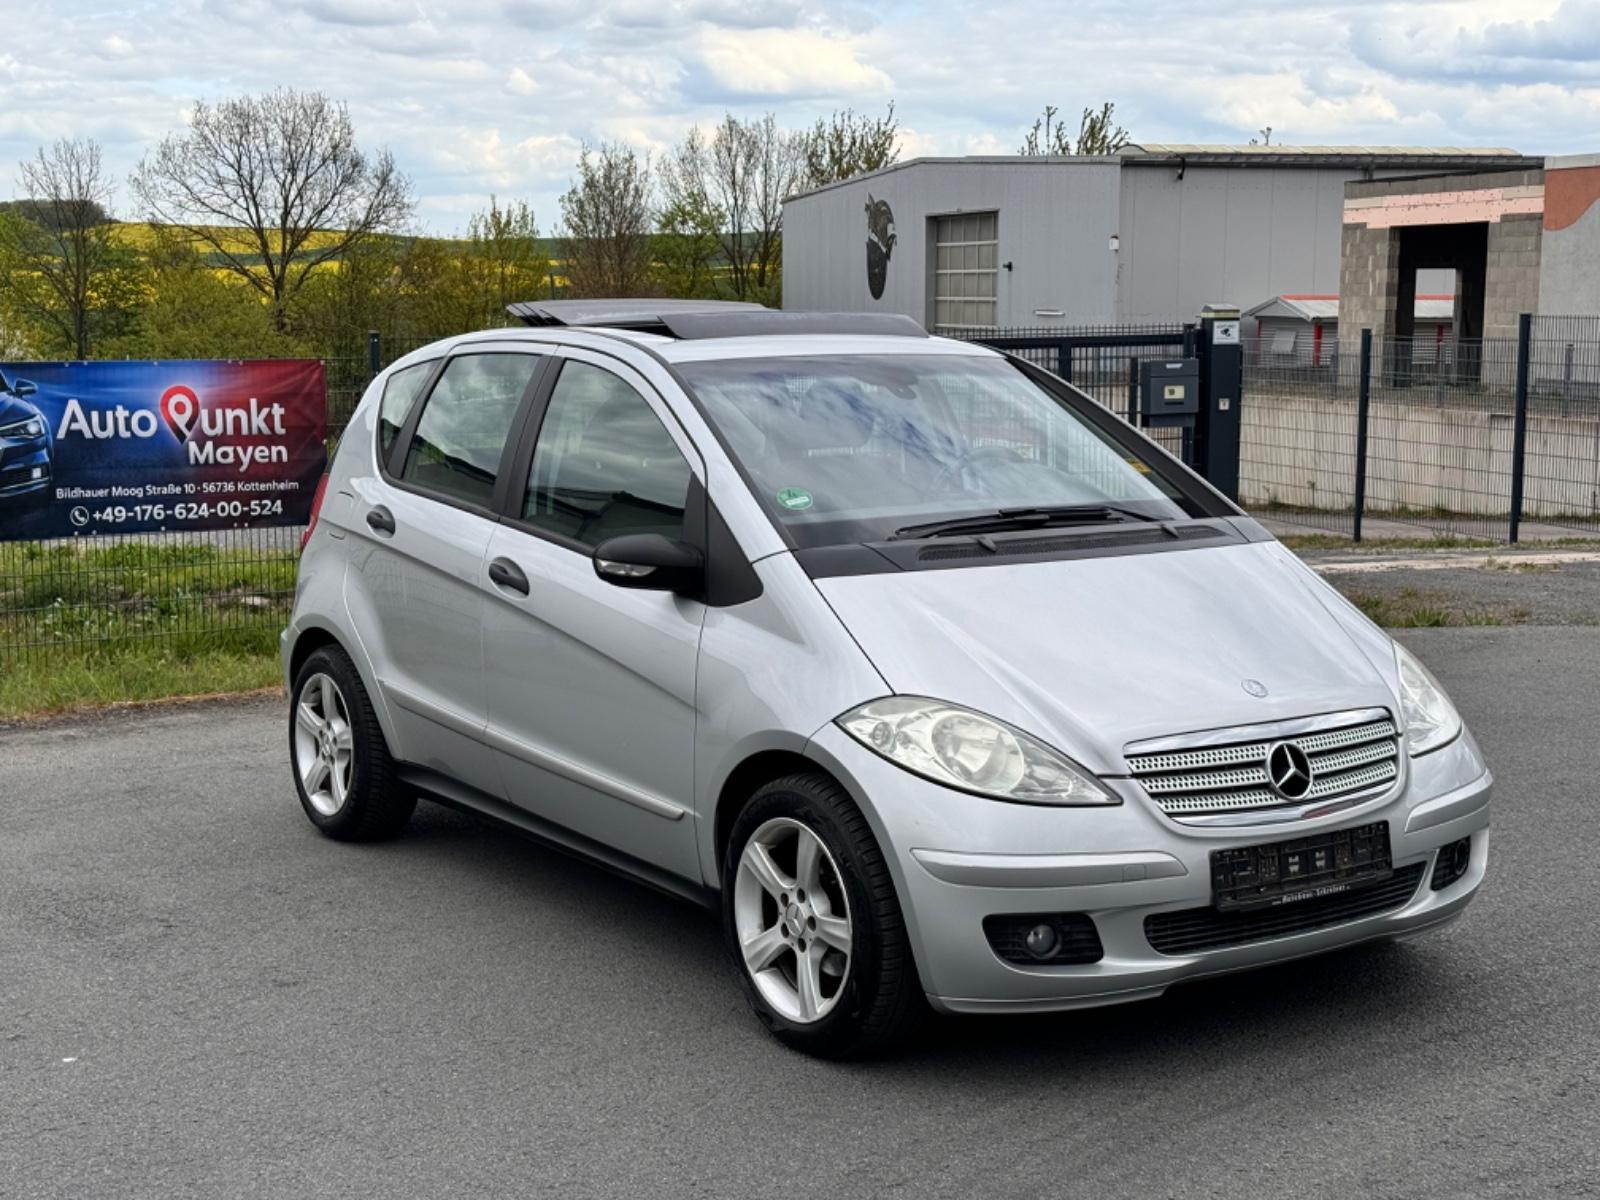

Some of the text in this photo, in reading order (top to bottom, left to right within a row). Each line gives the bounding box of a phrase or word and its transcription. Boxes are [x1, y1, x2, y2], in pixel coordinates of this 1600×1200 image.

[56, 398, 158, 439] Auto
[188, 440, 288, 473] Mayen
[56, 479, 299, 499] Bildhauer Moog Straße 10 56736 Kottenheim
[92, 499, 283, 523] +49-176-624-00-524
